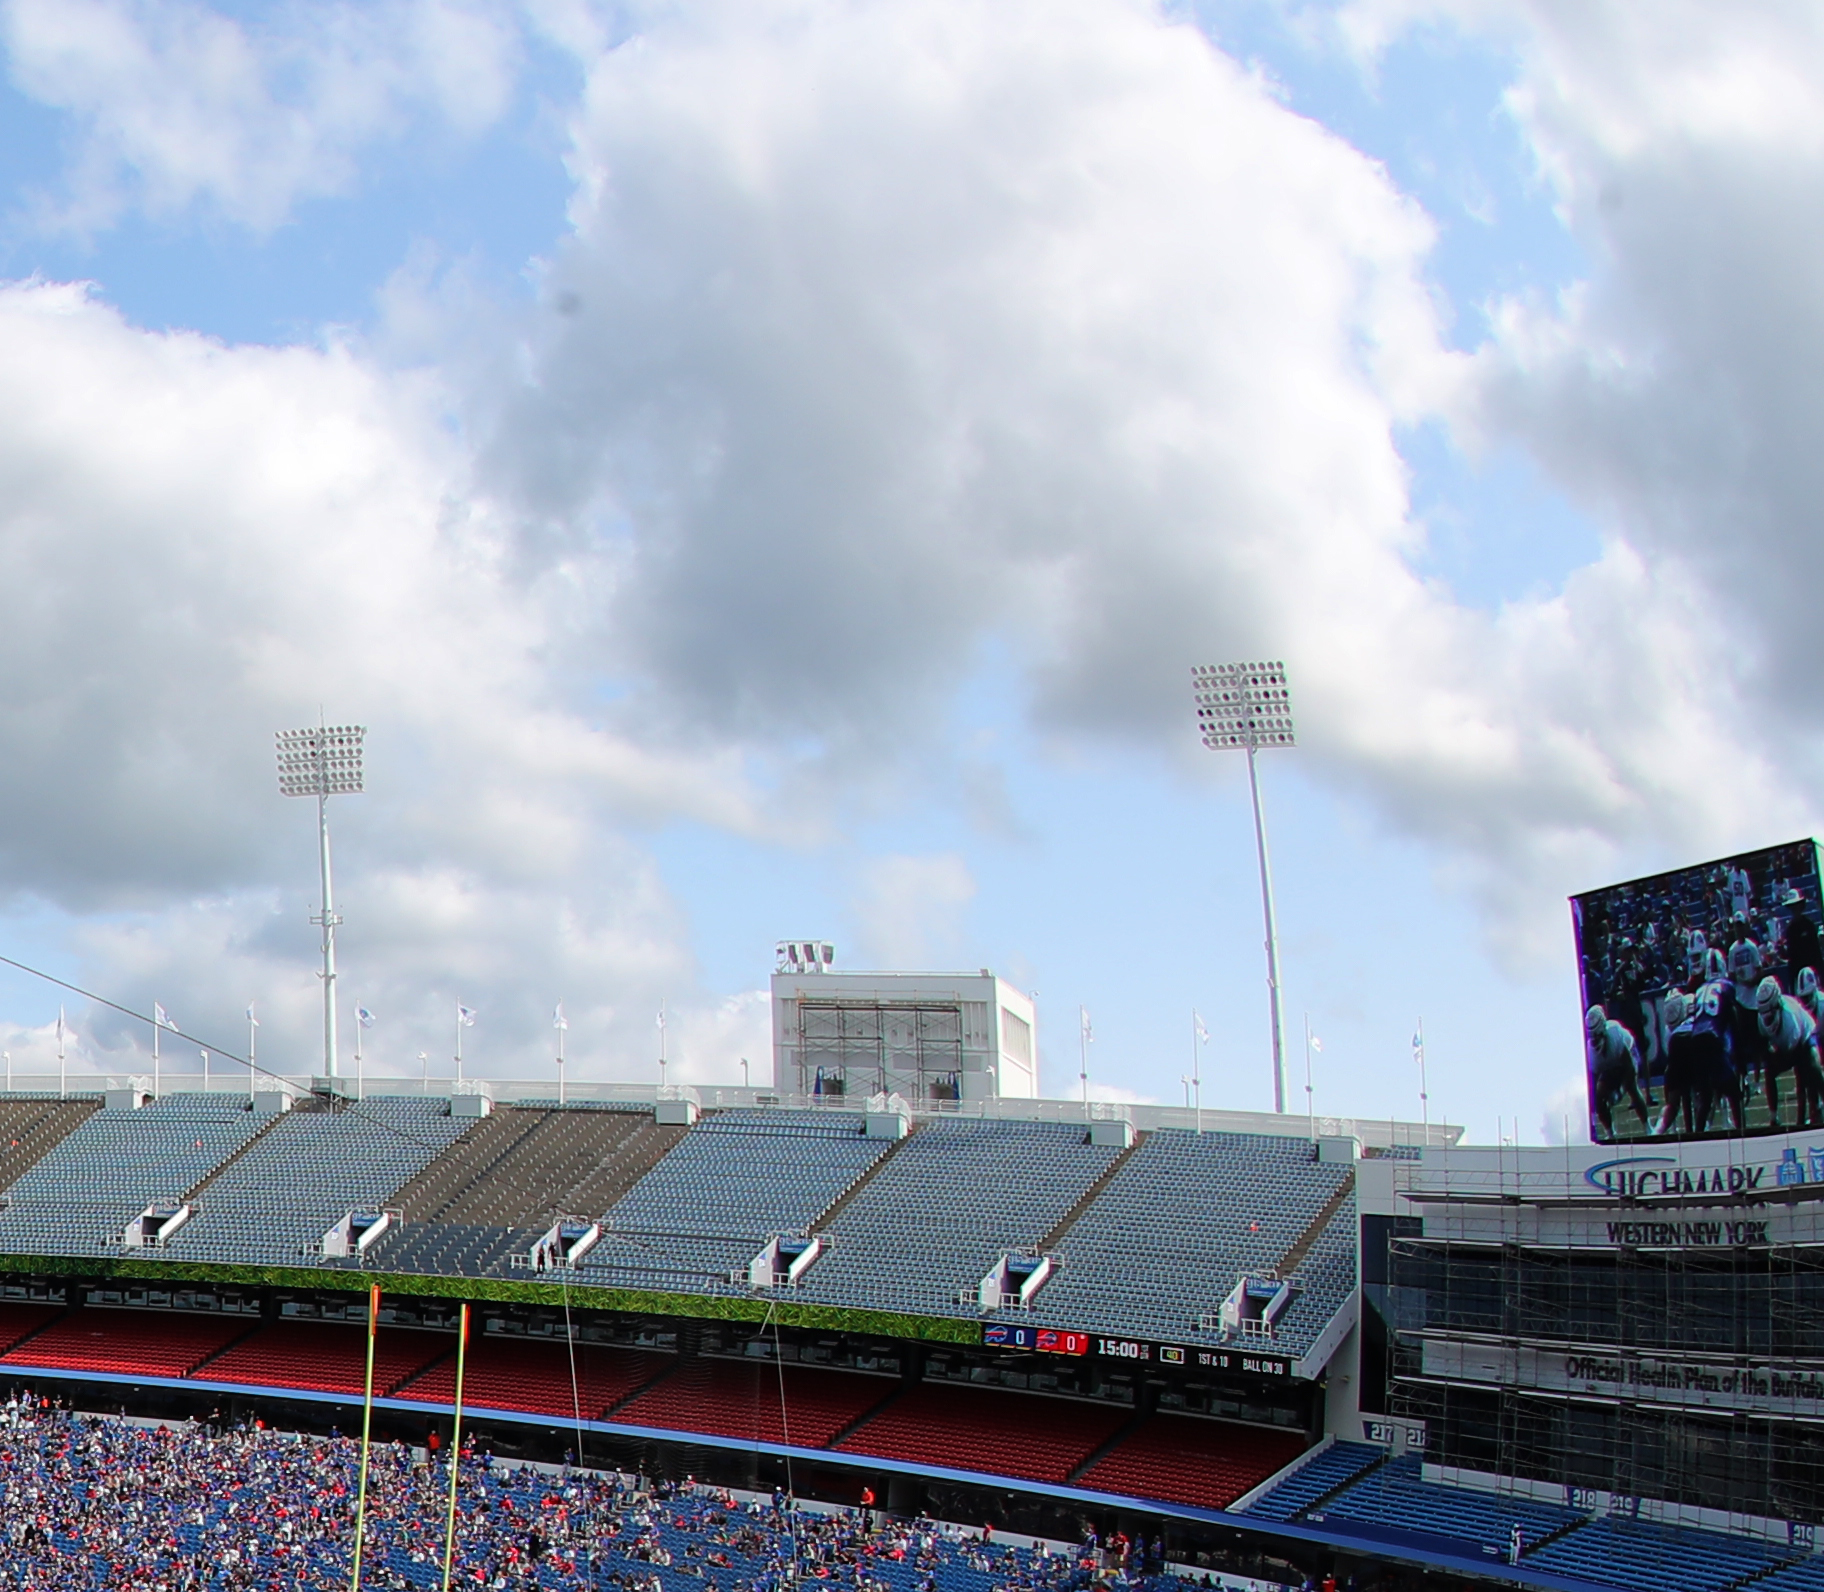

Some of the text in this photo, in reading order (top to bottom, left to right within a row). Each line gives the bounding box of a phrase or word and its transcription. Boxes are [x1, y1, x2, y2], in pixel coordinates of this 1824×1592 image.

[1606, 1220, 1770, 1245] WESTERN NEW YORK
[1015, 1329, 1025, 1345] 0
[1066, 1335, 1076, 1351] 0
[1098, 1339, 1138, 1359] 15:00
[1198, 1352, 1211, 1366] 1ST
[1242, 1358, 1284, 1375] BALL ON 30
[1565, 1355, 1624, 1385] Official
[1721, 1371, 1739, 1393] of
[1741, 1371, 1767, 1396] the
[1371, 1422, 1393, 1442] 217
[1572, 1489, 1596, 1511] 218
